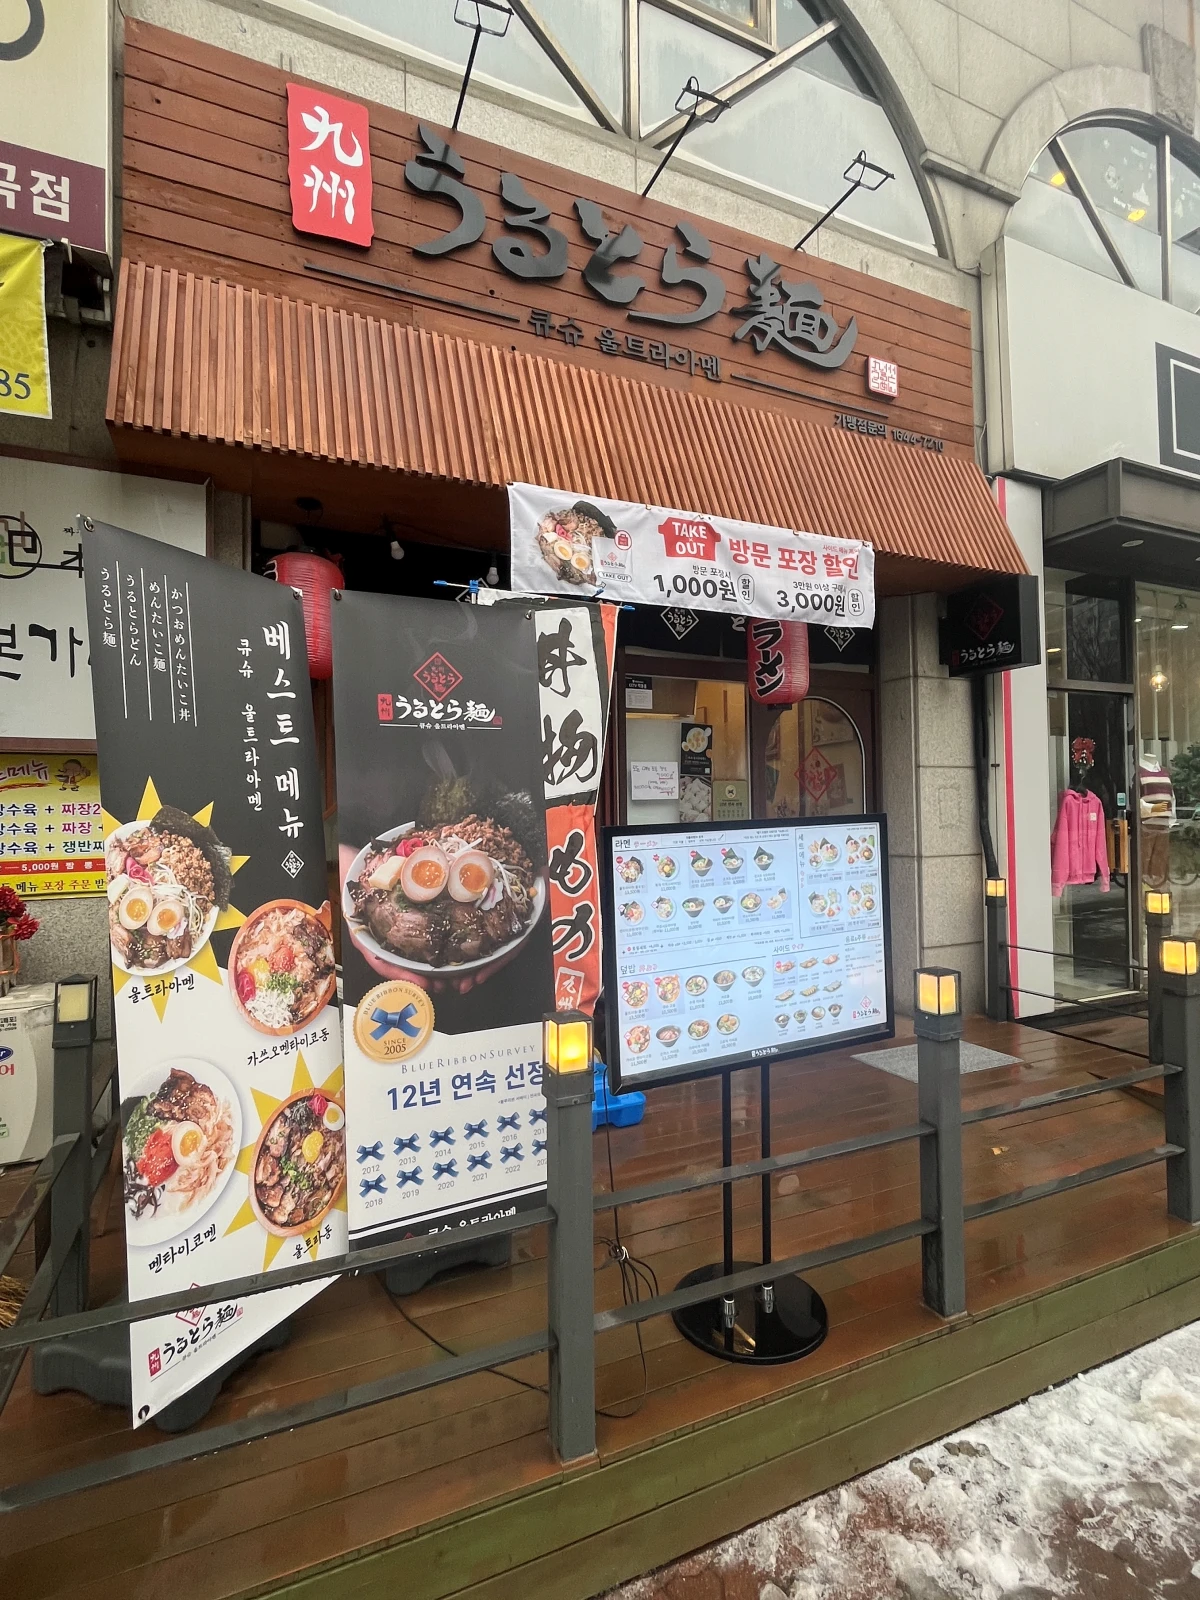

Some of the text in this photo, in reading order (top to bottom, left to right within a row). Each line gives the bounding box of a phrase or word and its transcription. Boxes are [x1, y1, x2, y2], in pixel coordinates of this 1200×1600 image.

[300, 105, 363, 224] 九州
[404, 123, 858, 369] うるとら麺
[528, 309, 584, 347] 큐슈
[834, 413, 944, 452] 가맹점문의 1644-7210
[671, 521, 707, 540] TAKE
[675, 541, 706, 557] OUT
[728, 538, 859, 581] 방문 포장 할인
[692, 565, 732, 580] 방문 포장시
[792, 581, 812, 592] 3만원
[813, 583, 830, 593] 이상
[653, 574, 738, 603] 1,000원
[100, 568, 117, 648] うるとら麺
[667, 611, 693, 627] うるとら
[776, 590, 846, 618] 3,000원
[126, 574, 142, 666] うるとらどん
[149, 582, 167, 672] めんたいこ麺
[752, 620, 785, 698] ラーメン
[960, 641, 1015, 664] うるとら麺
[395, 694, 496, 723] うるとら麺
[236, 638, 263, 812] 큐슈 울트라아멘
[262, 620, 304, 839] 베스트 메뉴
[62, 821, 92, 835] 짜장
[615, 838, 631, 849] 라멘
[21, 862, 59, 872] 5,000원
[15, 881, 39, 893] 메뉴
[42, 880, 66, 891] 포장
[69, 880, 91, 890] 주문
[773, 943, 791, 953] 사이드
[620, 964, 636, 975] 덮밥
[128, 973, 195, 1004] 울트라아멘
[376, 987, 404, 999] RIBBON
[404, 988, 426, 1007] SURVEY
[384, 1038, 406, 1046] SINCE
[384, 1043, 407, 1056] 2005
[387, 1077, 442, 1111] 12년
[451, 1069, 497, 1101] 연속
[362, 1164, 380, 1175] 2012
[398, 1156, 417, 1166] 2013
[434, 1148, 452, 1158] 2014
[468, 1141, 486, 1151] 2015
[502, 1134, 518, 1143] 2016
[364, 1198, 383, 1209] 2018
[401, 1189, 420, 1199] 2019
[437, 1181, 455, 1191] 2020
[472, 1172, 488, 1182] 2021
[505, 1164, 521, 1174] 2022
[148, 1223, 217, 1274] 멘타이코멘
[292, 1224, 333, 1260] 울트라동
[163, 1303, 238, 1364] うるとら麺
